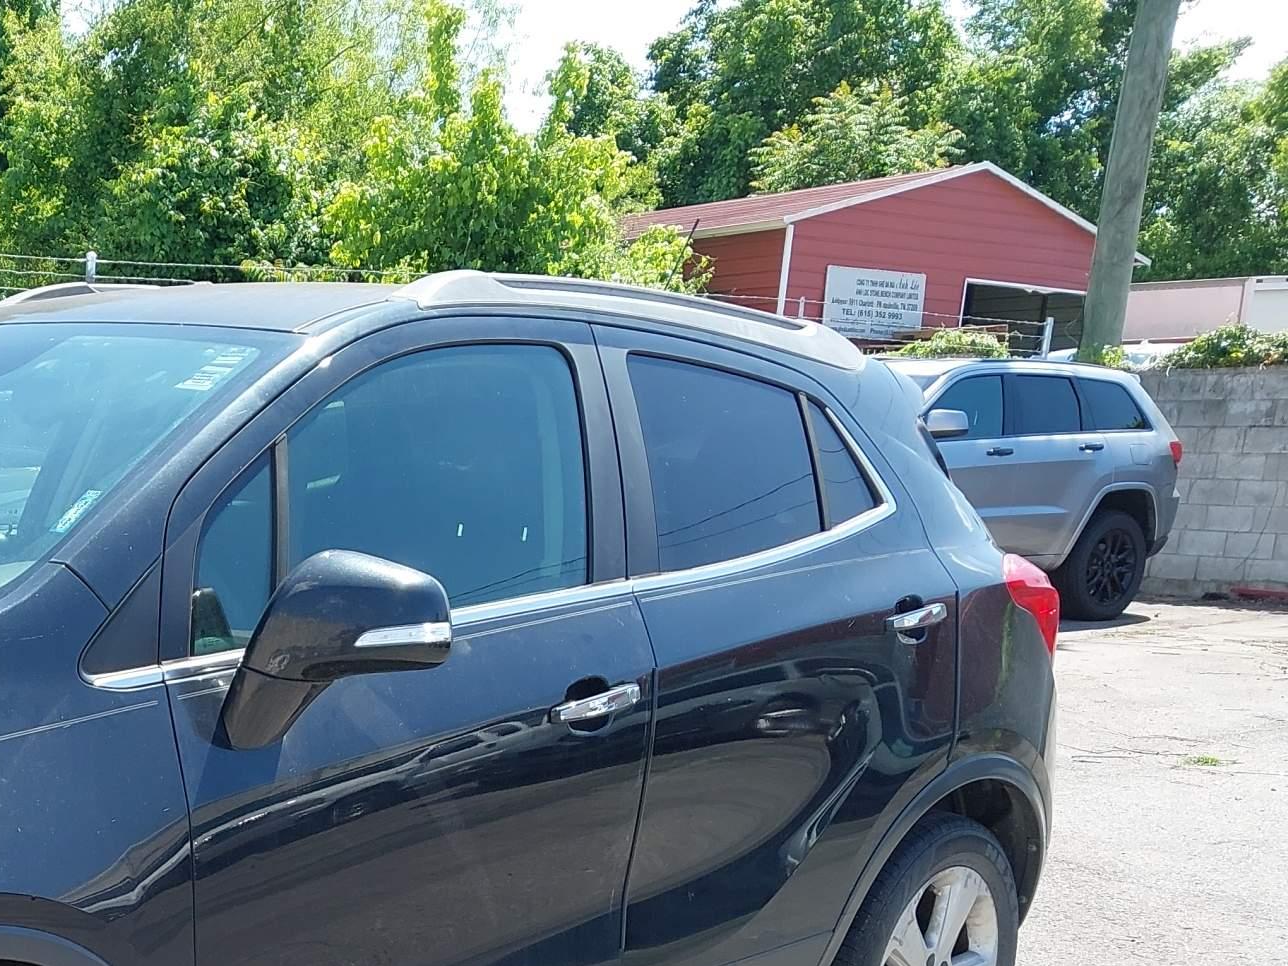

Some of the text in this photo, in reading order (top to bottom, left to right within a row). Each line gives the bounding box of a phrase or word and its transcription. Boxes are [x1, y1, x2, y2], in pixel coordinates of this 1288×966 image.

[842, 308, 903, 320] TEL: (615) 352 9993
